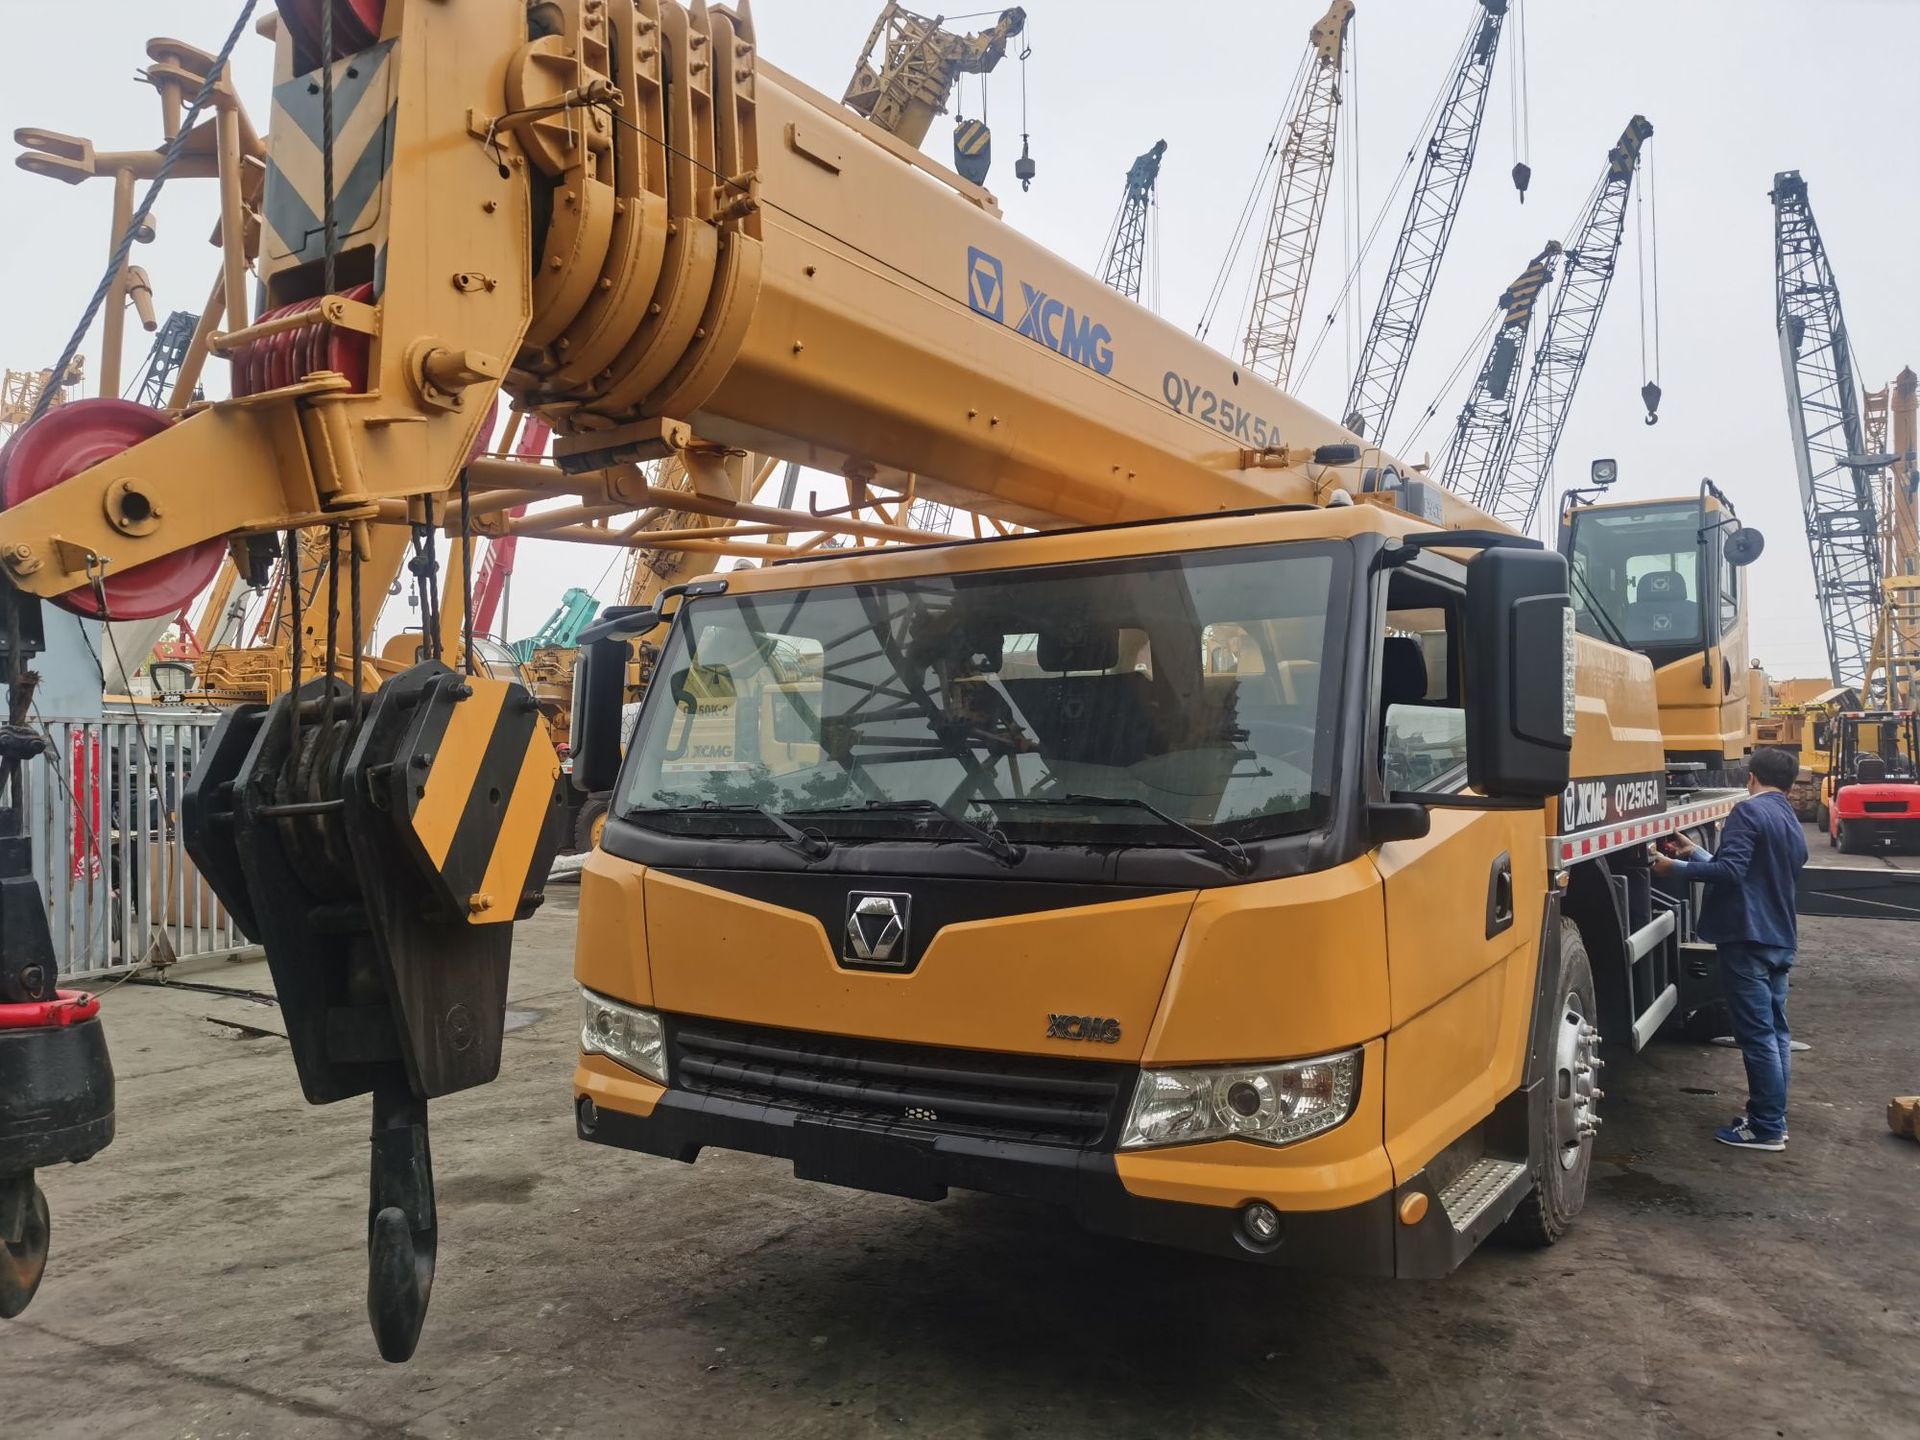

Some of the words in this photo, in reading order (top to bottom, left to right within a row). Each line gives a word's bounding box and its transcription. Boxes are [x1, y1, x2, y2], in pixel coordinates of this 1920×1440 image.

[1016, 281, 1113, 375] XCMG
[1163, 371, 1281, 449] QY25K5A
[163, 695, 181, 703] XCMG
[691, 745, 733, 758] XCMG
[1576, 781, 1607, 826] XCMG
[1615, 780, 1659, 817] QY25K5A
[1046, 1013, 1122, 1044] XCMG
